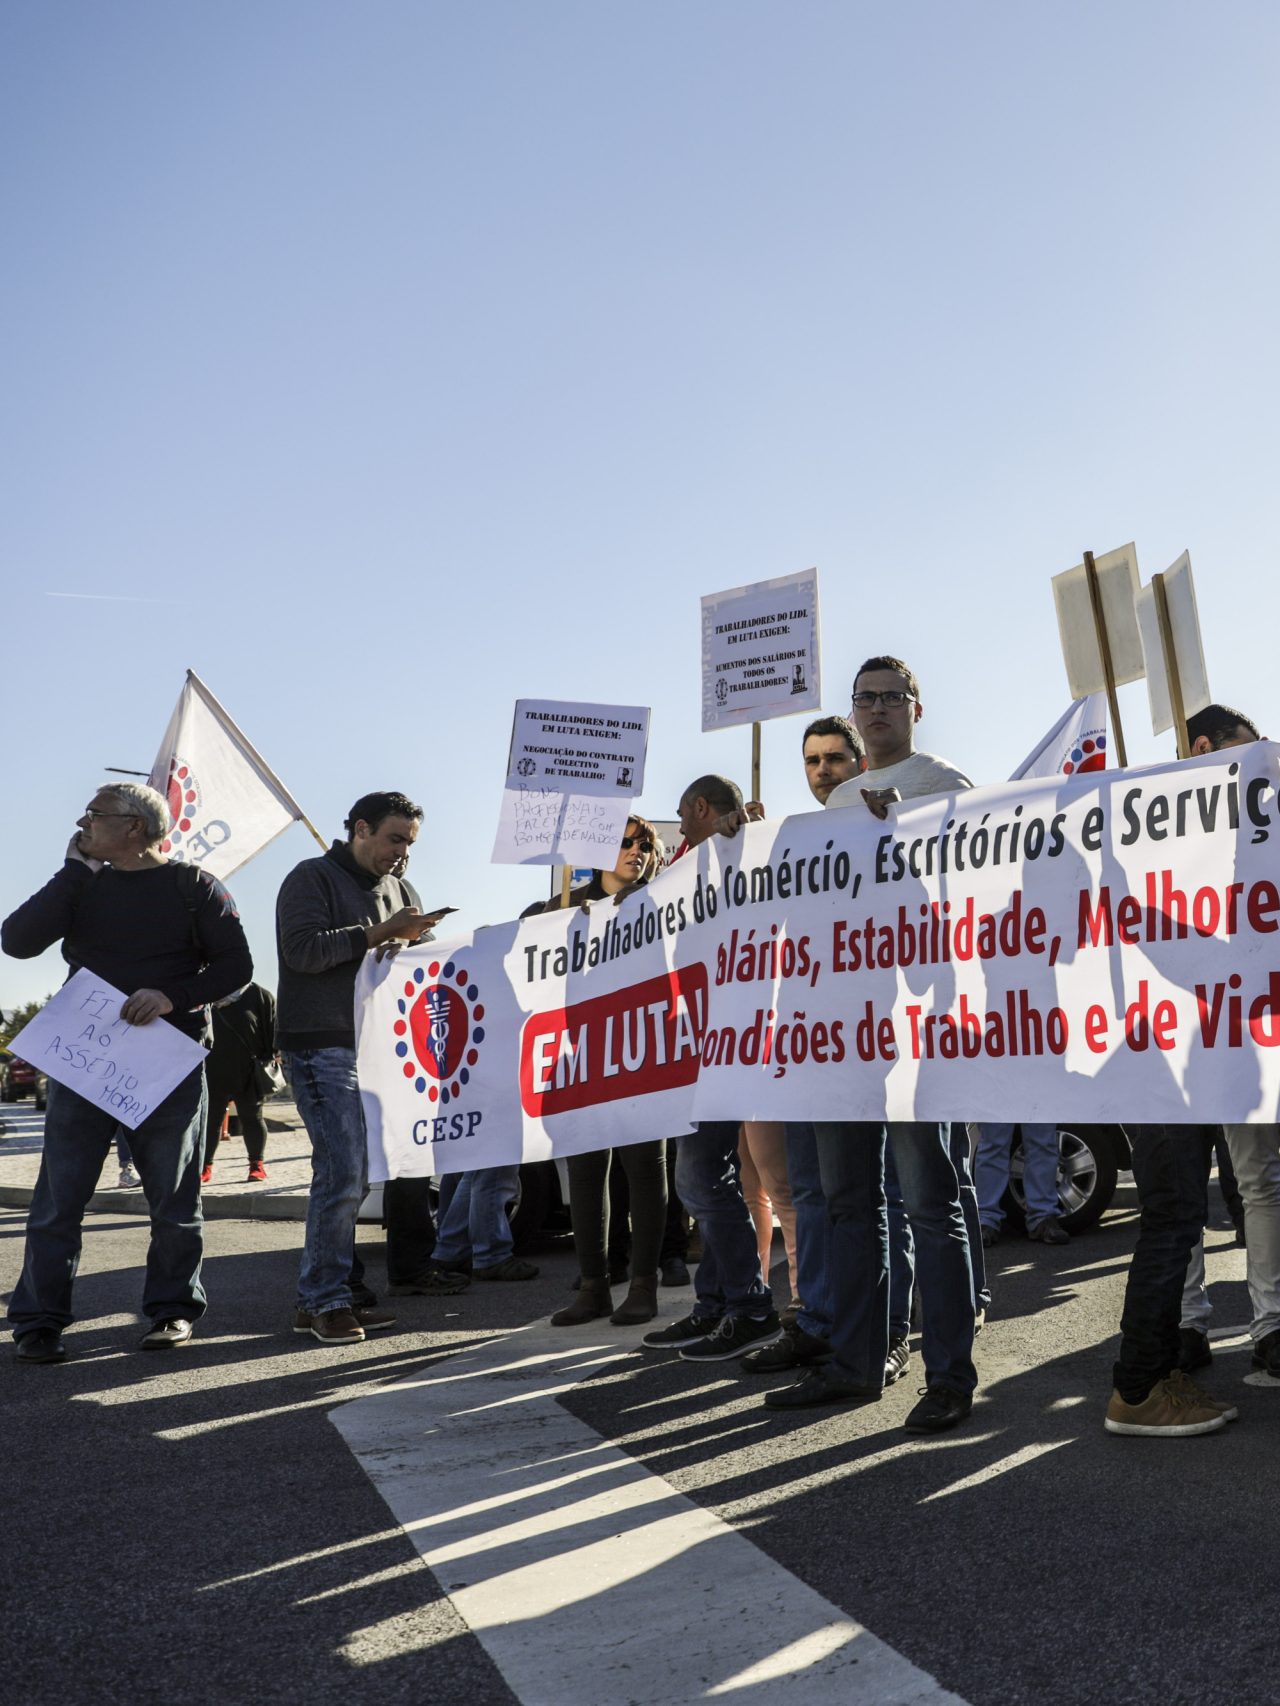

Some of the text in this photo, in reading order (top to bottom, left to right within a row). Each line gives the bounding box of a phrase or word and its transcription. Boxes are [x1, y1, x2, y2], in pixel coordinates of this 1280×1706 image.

[715, 608, 809, 635] TRABALHADORES DO LIDL
[727, 625, 791, 645] EM LUTA EXIGEM:
[715, 649, 807, 673] AUMENTOS DOS SALÁRIOS DE
[742, 666, 776, 679] TODOS OS
[729, 676, 789, 693] TRABALHADORES!
[525, 711, 644, 731] TRABALHADORES DO LIDL
[541, 724, 622, 740] EM LUTA EXIGEM:
[522, 745, 635, 763] NEGOCIAÇÃO DO CONTRATO
[553, 758, 600, 769] COLECTIVO
[544, 767, 606, 781] DE TRABALHO!
[524, 897, 685, 983] Trabalhadores
[692, 873, 717, 924] do
[724, 840, 862, 908] Comércio,
[875, 805, 1067, 883] Escritórios
[1081, 806, 1105, 851] e
[715, 924, 821, 987] lários,
[832, 890, 1062, 973] Estabilidade,
[80, 990, 133, 1036] FI
[78, 1023, 111, 1047] AO
[702, 1008, 846, 1079] ondições
[856, 1001, 897, 1062] de
[905, 989, 1069, 1060] Trabalho
[1084, 1004, 1109, 1053] e
[1125, 980, 1178, 1052] de
[533, 1024, 588, 1094] EM
[99, 1084, 148, 1124] MORAL
[412, 1111, 482, 1146] CESP
